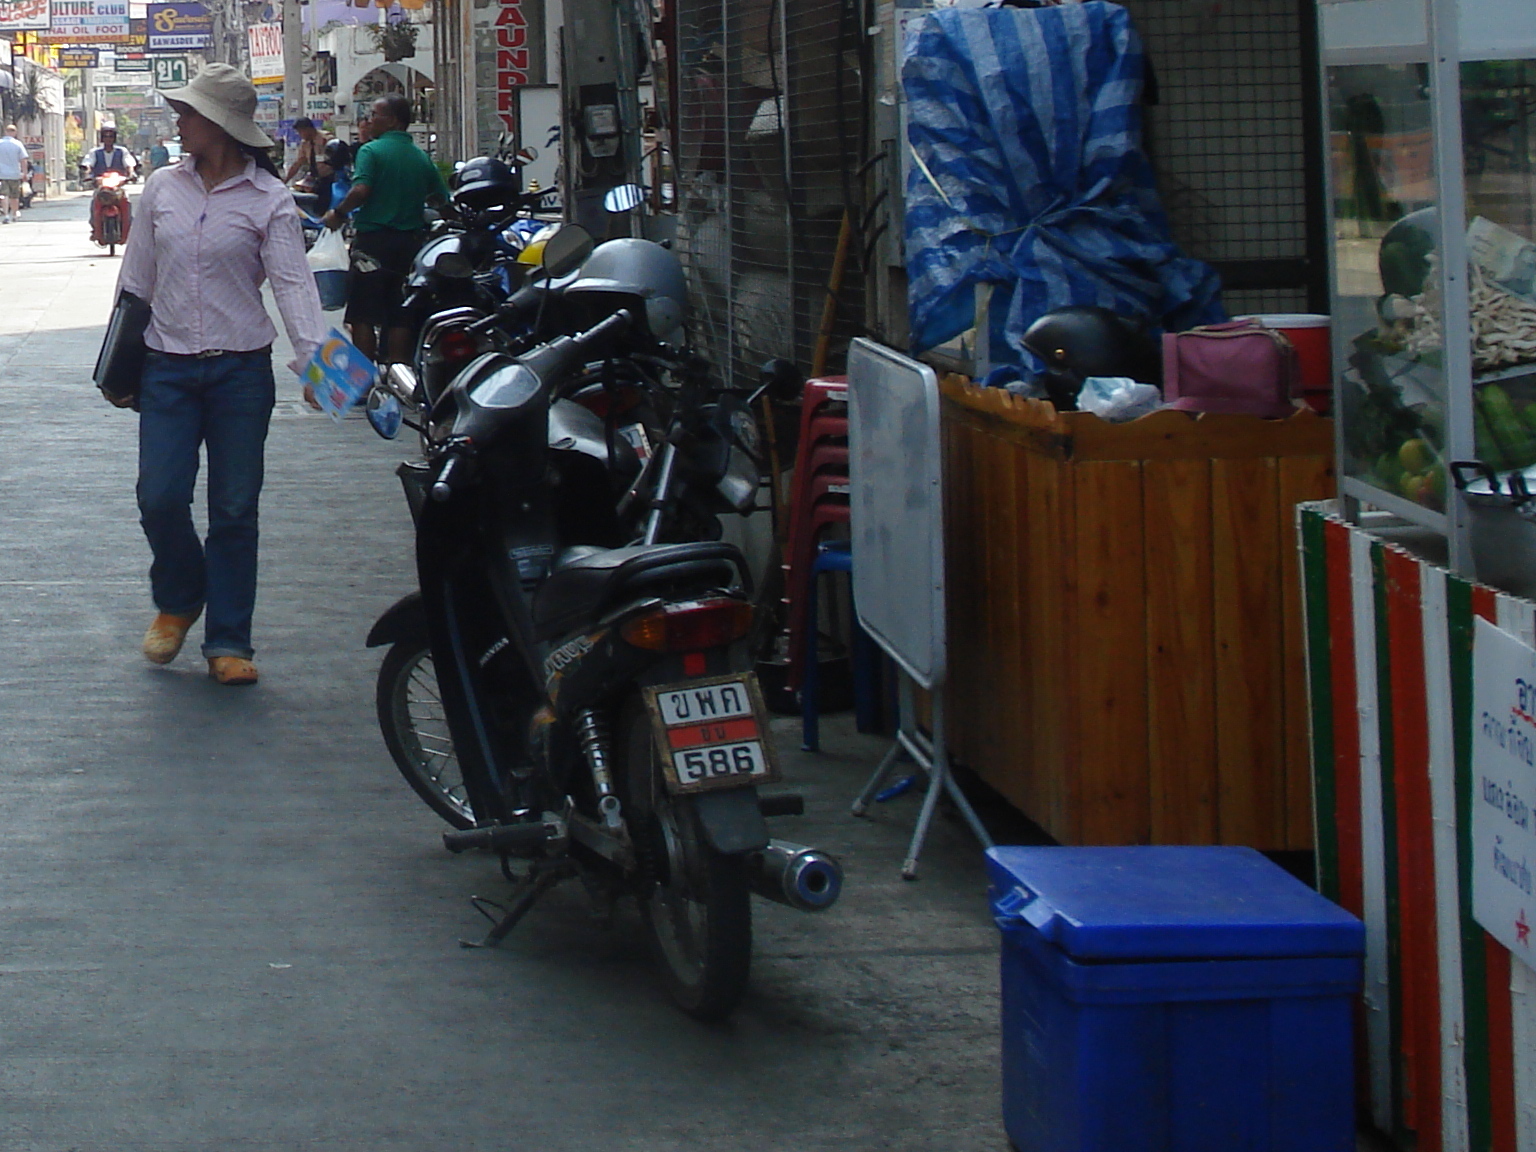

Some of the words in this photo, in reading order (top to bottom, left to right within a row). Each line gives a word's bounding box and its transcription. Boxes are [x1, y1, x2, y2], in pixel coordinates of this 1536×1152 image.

[97, 3, 125, 15] CLUB
[73, 25, 90, 34] OIL
[96, 25, 124, 33] FOOT
[156, 60, 187, 82] ยา
[684, 747, 754, 779] 586
